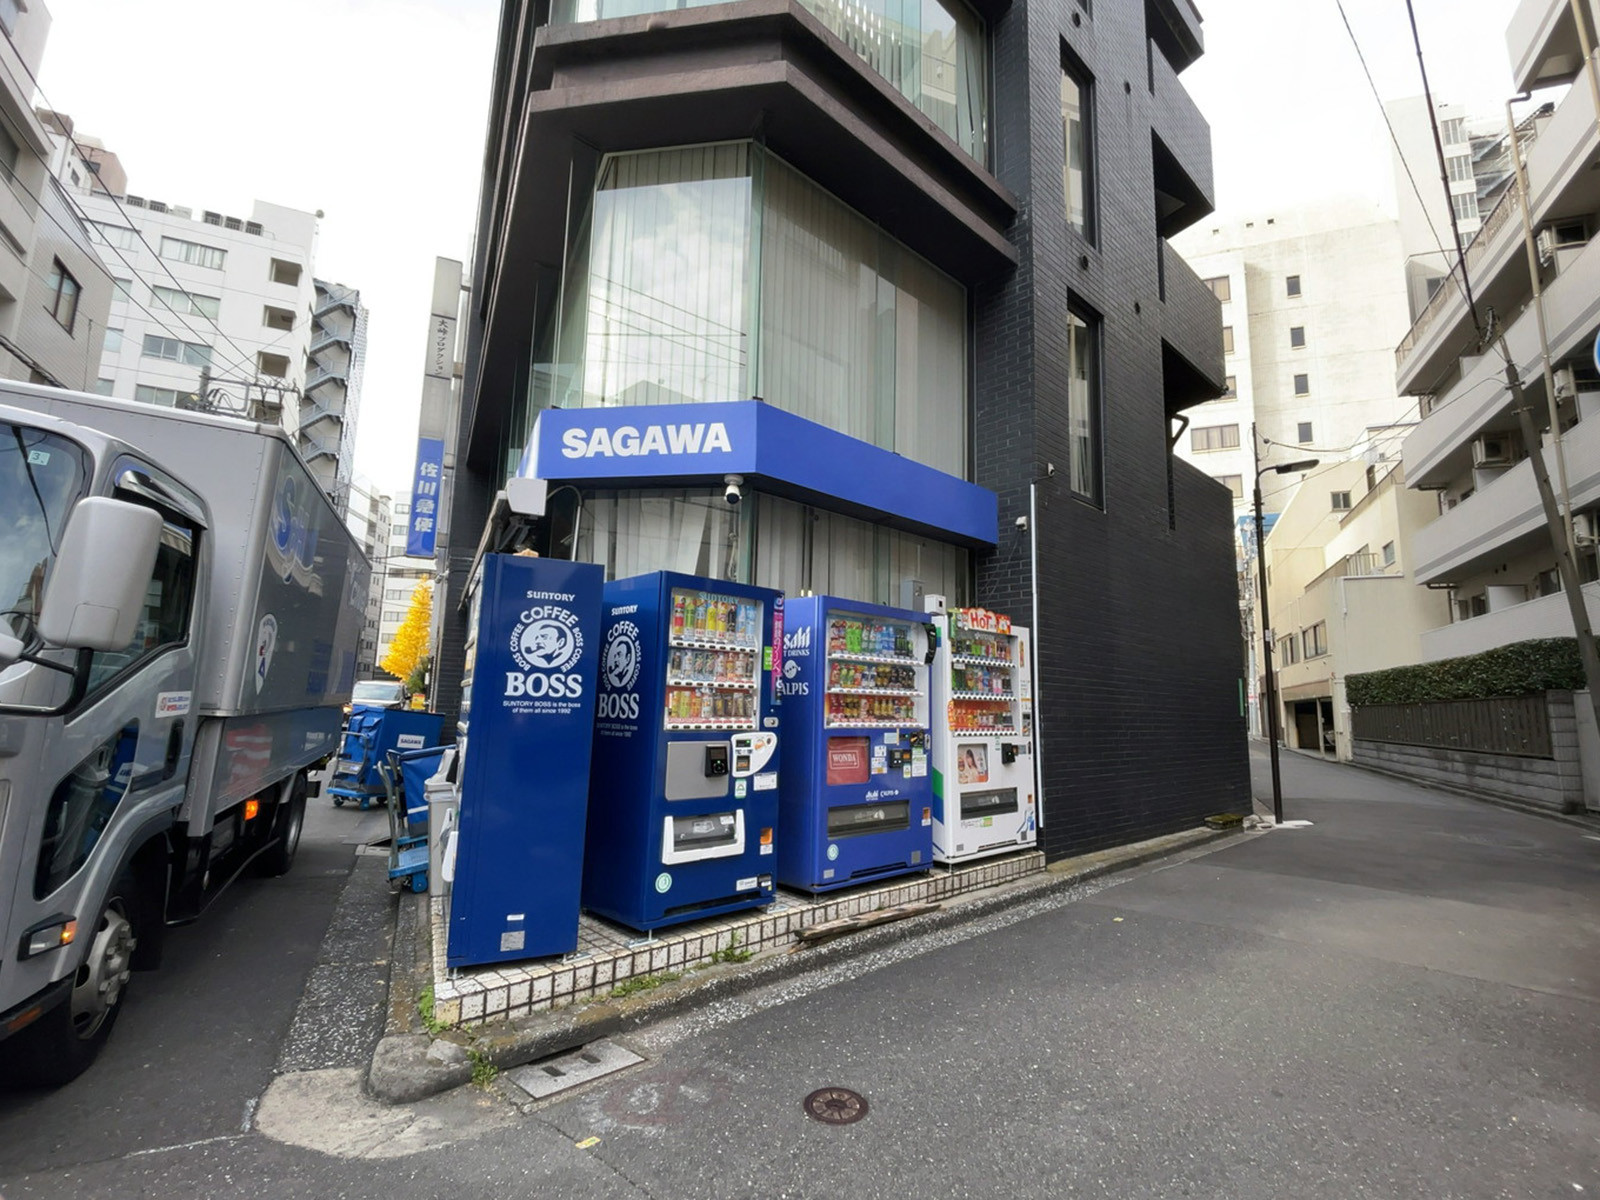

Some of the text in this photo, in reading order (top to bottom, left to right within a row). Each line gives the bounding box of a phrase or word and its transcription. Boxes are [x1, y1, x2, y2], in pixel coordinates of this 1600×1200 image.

[561, 422, 732, 459] SAGAWA
[414, 461, 439, 532] 佐川急便
[526, 590, 576, 602] SUNTORY
[520, 605, 579, 628] COFFEE
[611, 604, 639, 616] SUNTORY
[607, 620, 640, 642] COFFEE
[783, 625, 811, 650] sahi
[510, 622, 531, 671] BOSS COFFEE
[560, 626, 584, 673] BOSS COFFEE
[504, 671, 583, 698] BOSS
[782, 681, 809, 696] ALPIS
[597, 692, 641, 720] BOSS
